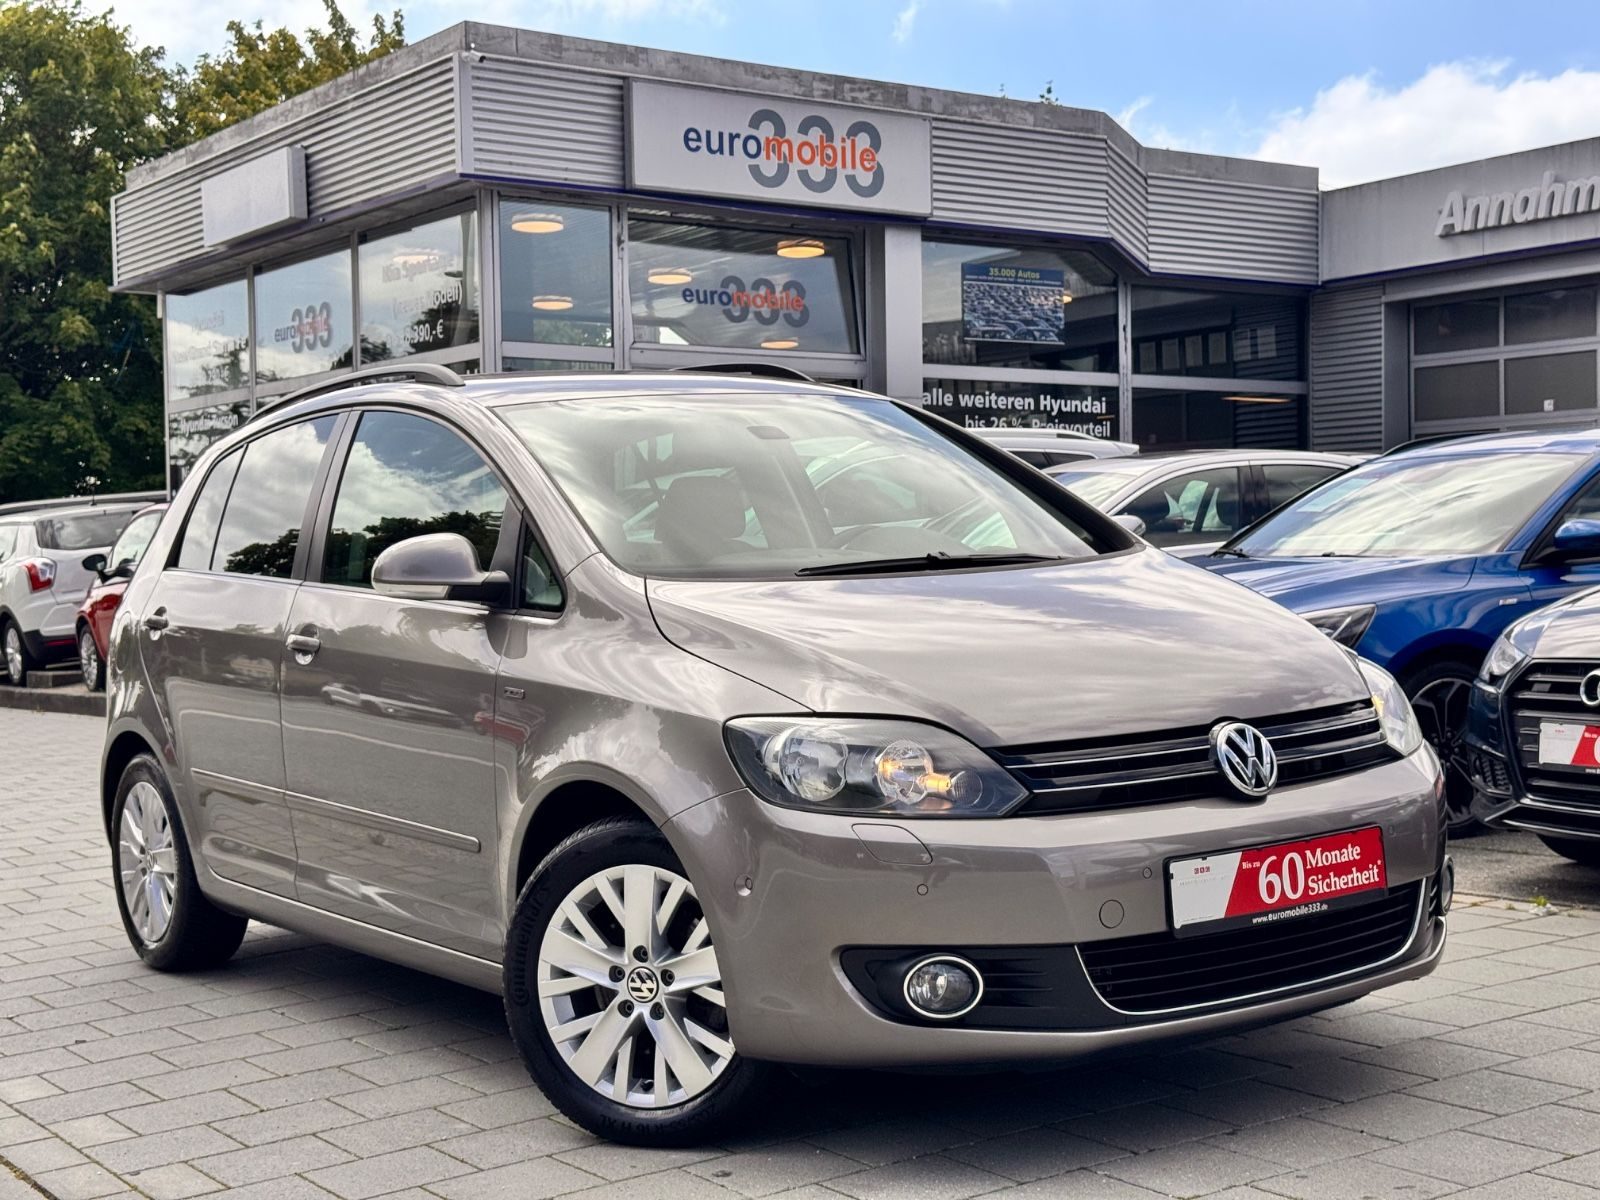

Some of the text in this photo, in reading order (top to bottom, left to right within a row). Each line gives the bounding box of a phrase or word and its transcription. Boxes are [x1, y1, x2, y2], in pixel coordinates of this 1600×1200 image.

[683, 126, 878, 172] euromobile
[747, 108, 885, 198] 333
[989, 267, 1016, 277] 35.000
[1017, 270, 1041, 280] Autos
[682, 285, 804, 312] euromobile
[720, 275, 810, 328] 333
[922, 388, 1106, 417] alle weiteren Hyundai
[965, 414, 986, 429] bis
[990, 416, 1008, 429] 26
[1305, 842, 1361, 869] Monate
[1258, 851, 1306, 905] 60
[1252, 902, 1329, 924] www.euromobile333.de
